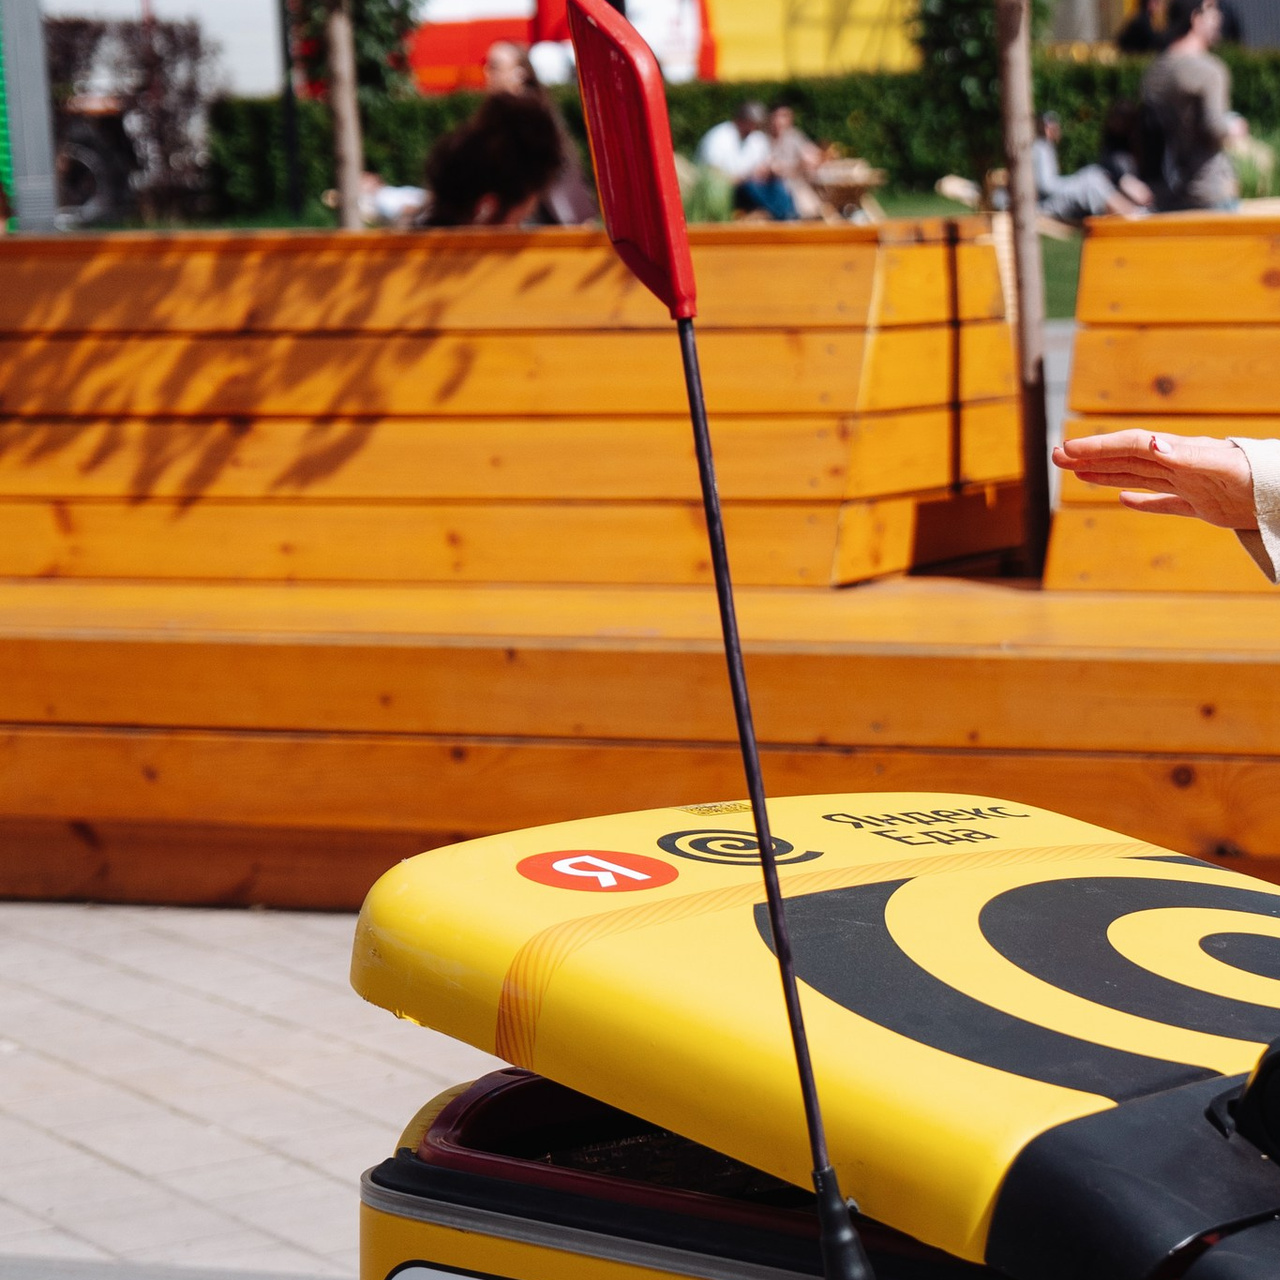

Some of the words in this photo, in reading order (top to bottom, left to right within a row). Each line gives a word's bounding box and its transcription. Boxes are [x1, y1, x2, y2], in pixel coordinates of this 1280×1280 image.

[822, 804, 1032, 830] Яндекс
[871, 825, 1000, 846] Еда
[551, 854, 653, 888] Я
